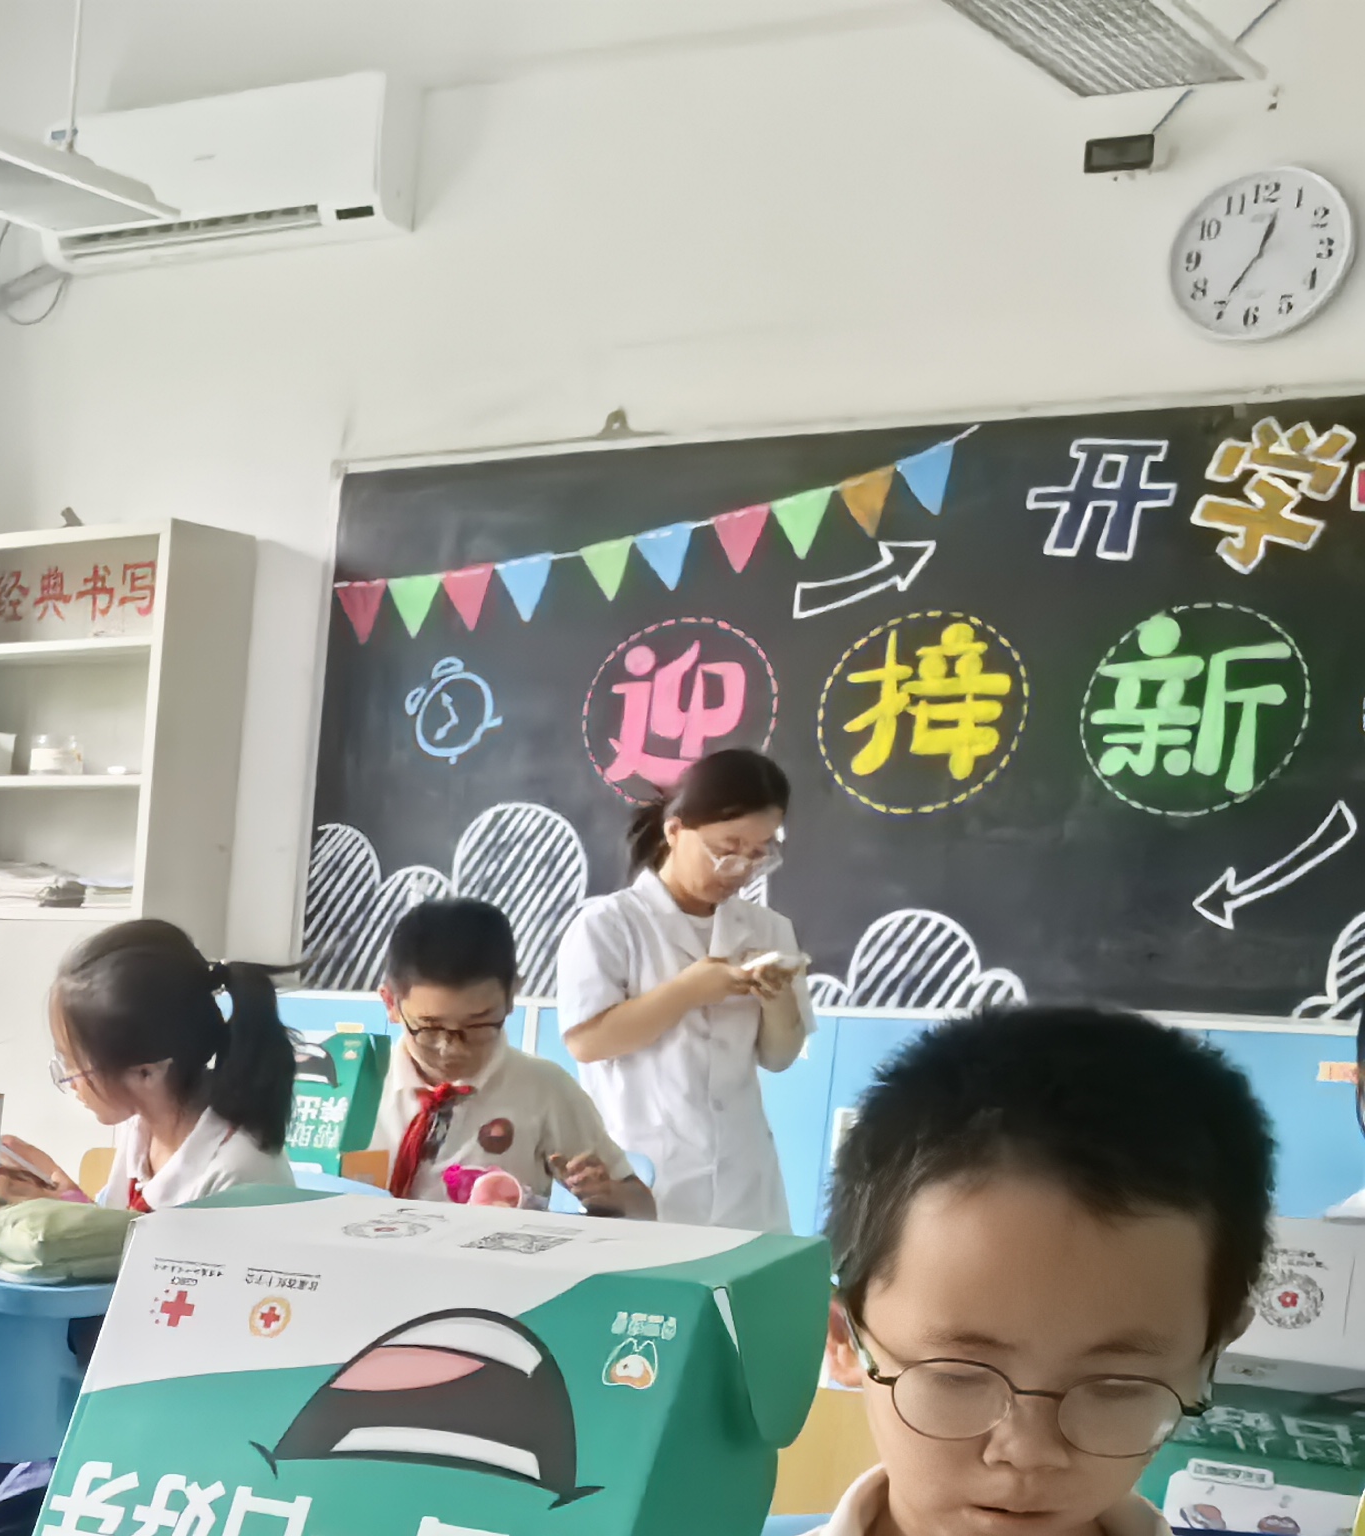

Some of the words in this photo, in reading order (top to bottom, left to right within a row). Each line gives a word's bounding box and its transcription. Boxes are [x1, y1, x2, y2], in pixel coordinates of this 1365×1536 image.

[1223, 192, 1247, 217] 11
[1252, 181, 1282, 205] 12
[1294, 185, 1305, 209] 1
[1199, 217, 1222, 242] 10
[1311, 206, 1331, 230] 2
[1316, 236, 1335, 260] 3
[1185, 250, 1203, 273] 9
[1190, 277, 1210, 301] 8
[1214, 300, 1231, 321] 7
[1242, 306, 1261, 328] 6
[1278, 294, 1295, 316] 5
[1026, 414, 1365, 576] 开学
